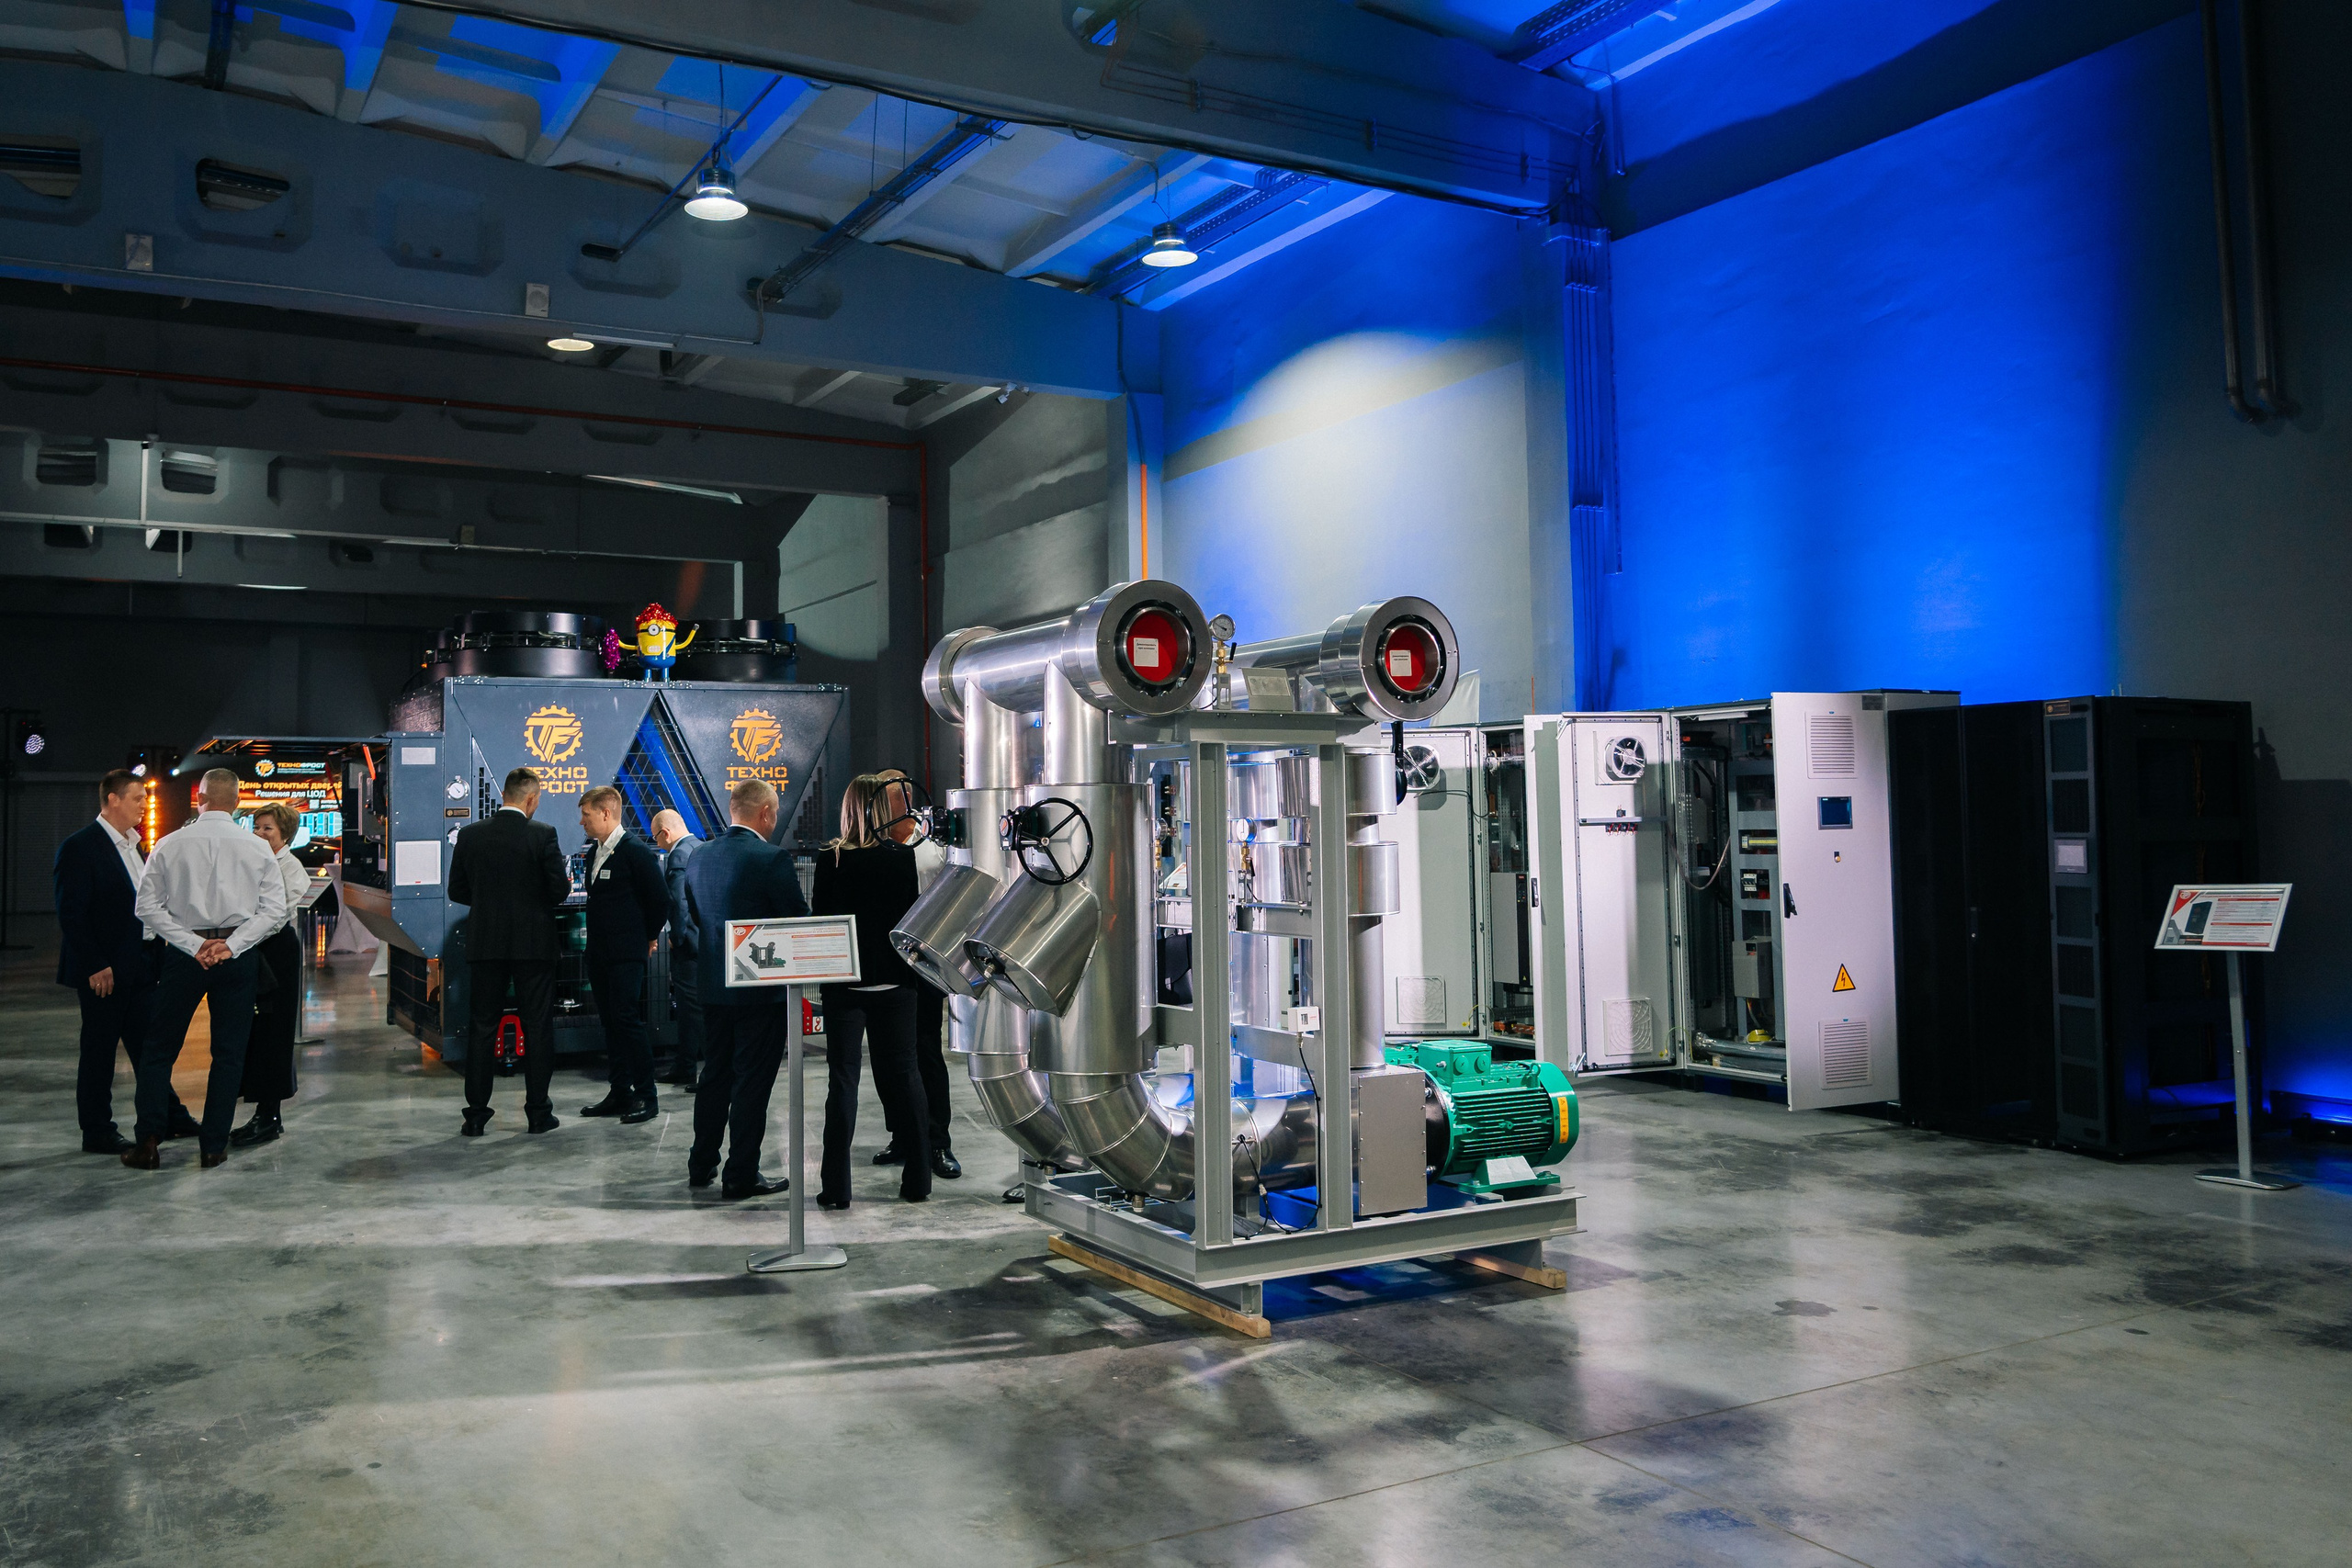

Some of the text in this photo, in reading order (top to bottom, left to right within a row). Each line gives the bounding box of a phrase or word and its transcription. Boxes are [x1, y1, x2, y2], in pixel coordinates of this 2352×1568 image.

[525, 766, 588, 779] ЕХНО
[726, 766, 787, 778] ТЕХНО
[238, 781, 262, 790] День
[263, 782, 310, 791] открытых
[538, 780, 589, 794] РОСТ
[254, 790, 290, 798] Решения
[306, 790, 326, 798] ЦОД
